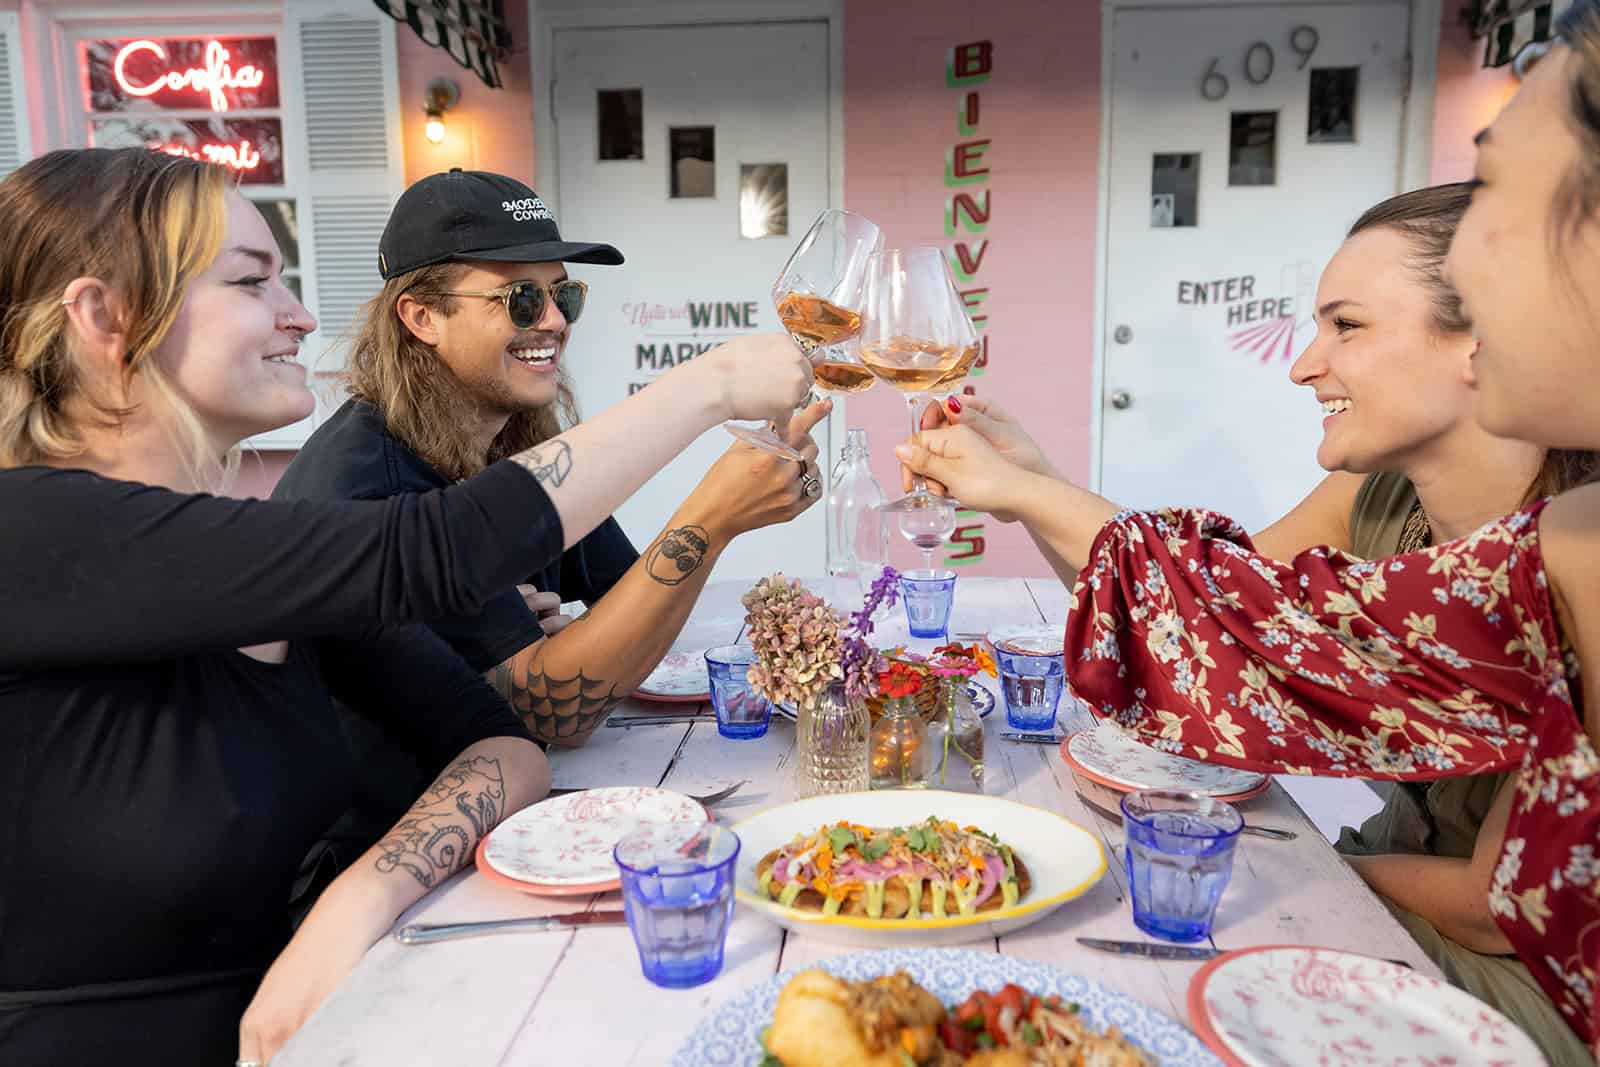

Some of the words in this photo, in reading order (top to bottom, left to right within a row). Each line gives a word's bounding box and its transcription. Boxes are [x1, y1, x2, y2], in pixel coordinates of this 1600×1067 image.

[1200, 25, 1320, 101] 609
[1177, 275, 1256, 305] ENTER
[688, 301, 759, 328] WINE
[1227, 297, 1295, 328] HERE
